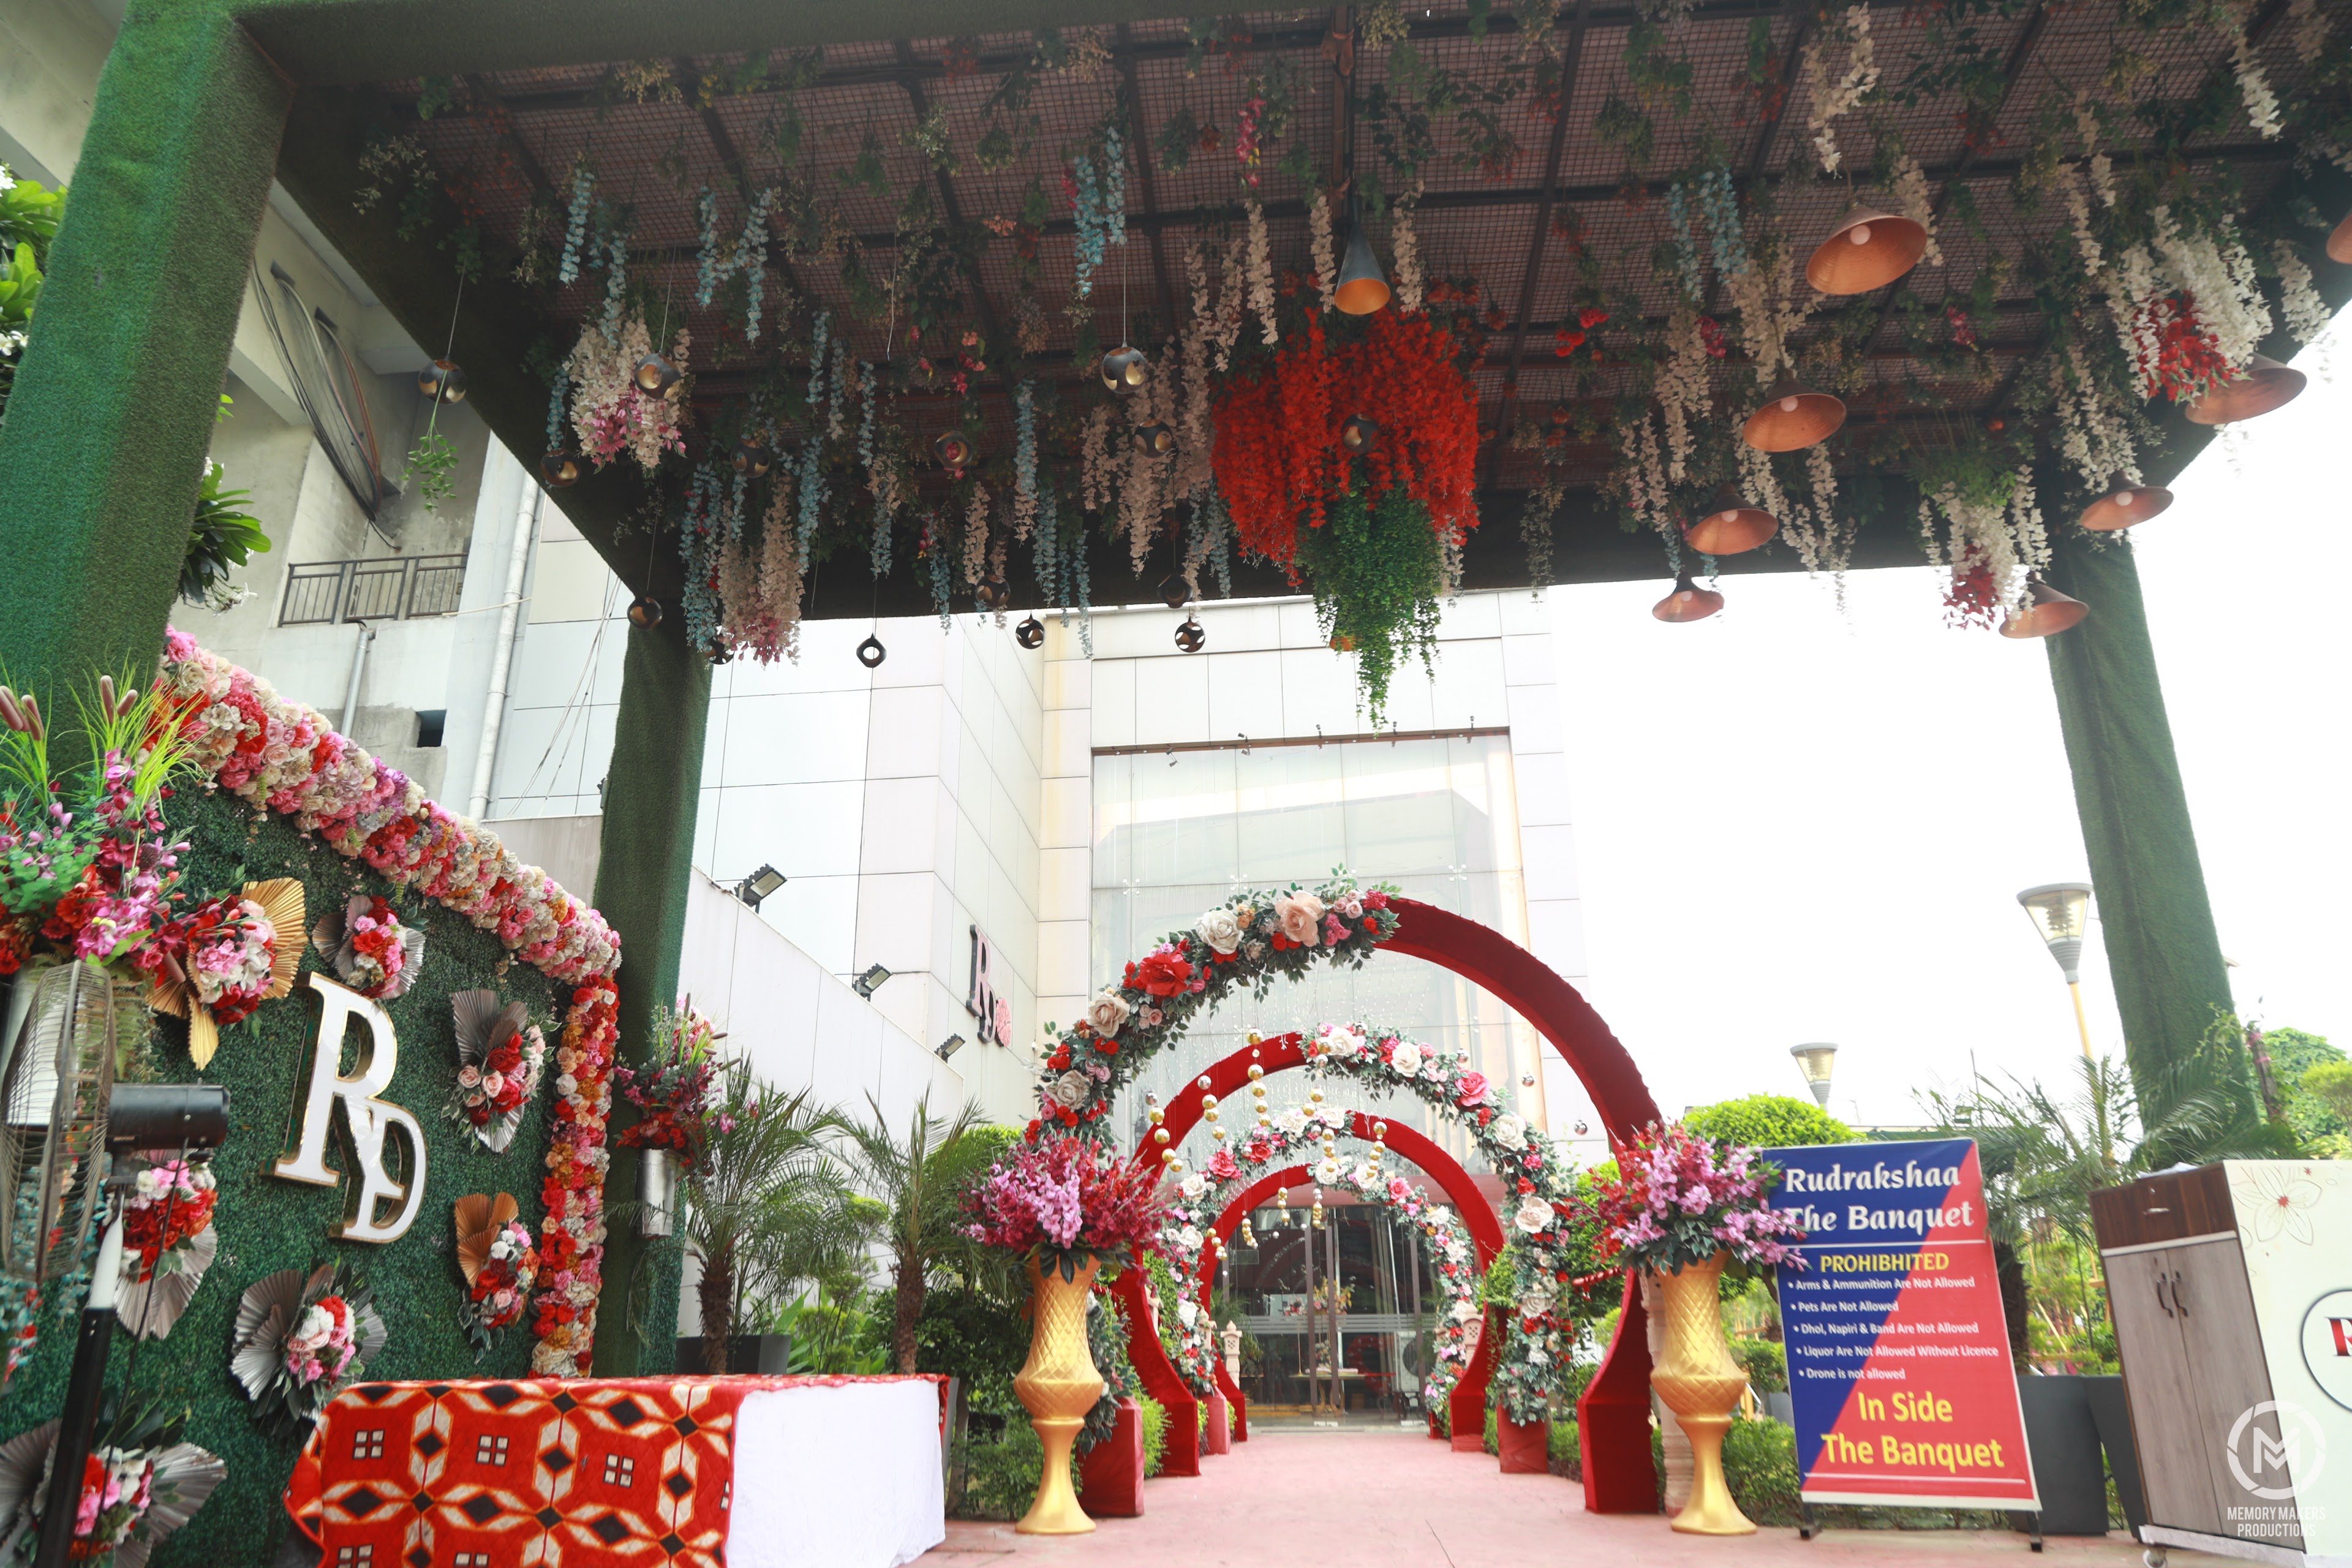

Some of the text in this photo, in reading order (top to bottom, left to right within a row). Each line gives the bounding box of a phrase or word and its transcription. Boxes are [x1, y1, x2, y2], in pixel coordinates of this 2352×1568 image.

[1785, 1160, 1961, 1193] Rudrakshaa
[1847, 1201, 1974, 1235] Banquet
[1820, 1252, 1950, 1272] PROHIBHITED
[1796, 1276, 1975, 1291] Arms & Ammunition Are Not Allowed
[1798, 1300, 1899, 1312] Pets Are Not Allowed
[1800, 1321, 1980, 1336] Dhol, Napiri & Band Are Not Allowed
[1803, 1344, 1999, 1359] Liquor Are Not Allowed Without Licence
[1806, 1367, 1906, 1379] Drone is not allowed
[1858, 1390, 1953, 1422] In Side
[1820, 1431, 2005, 1474] The Banquet
